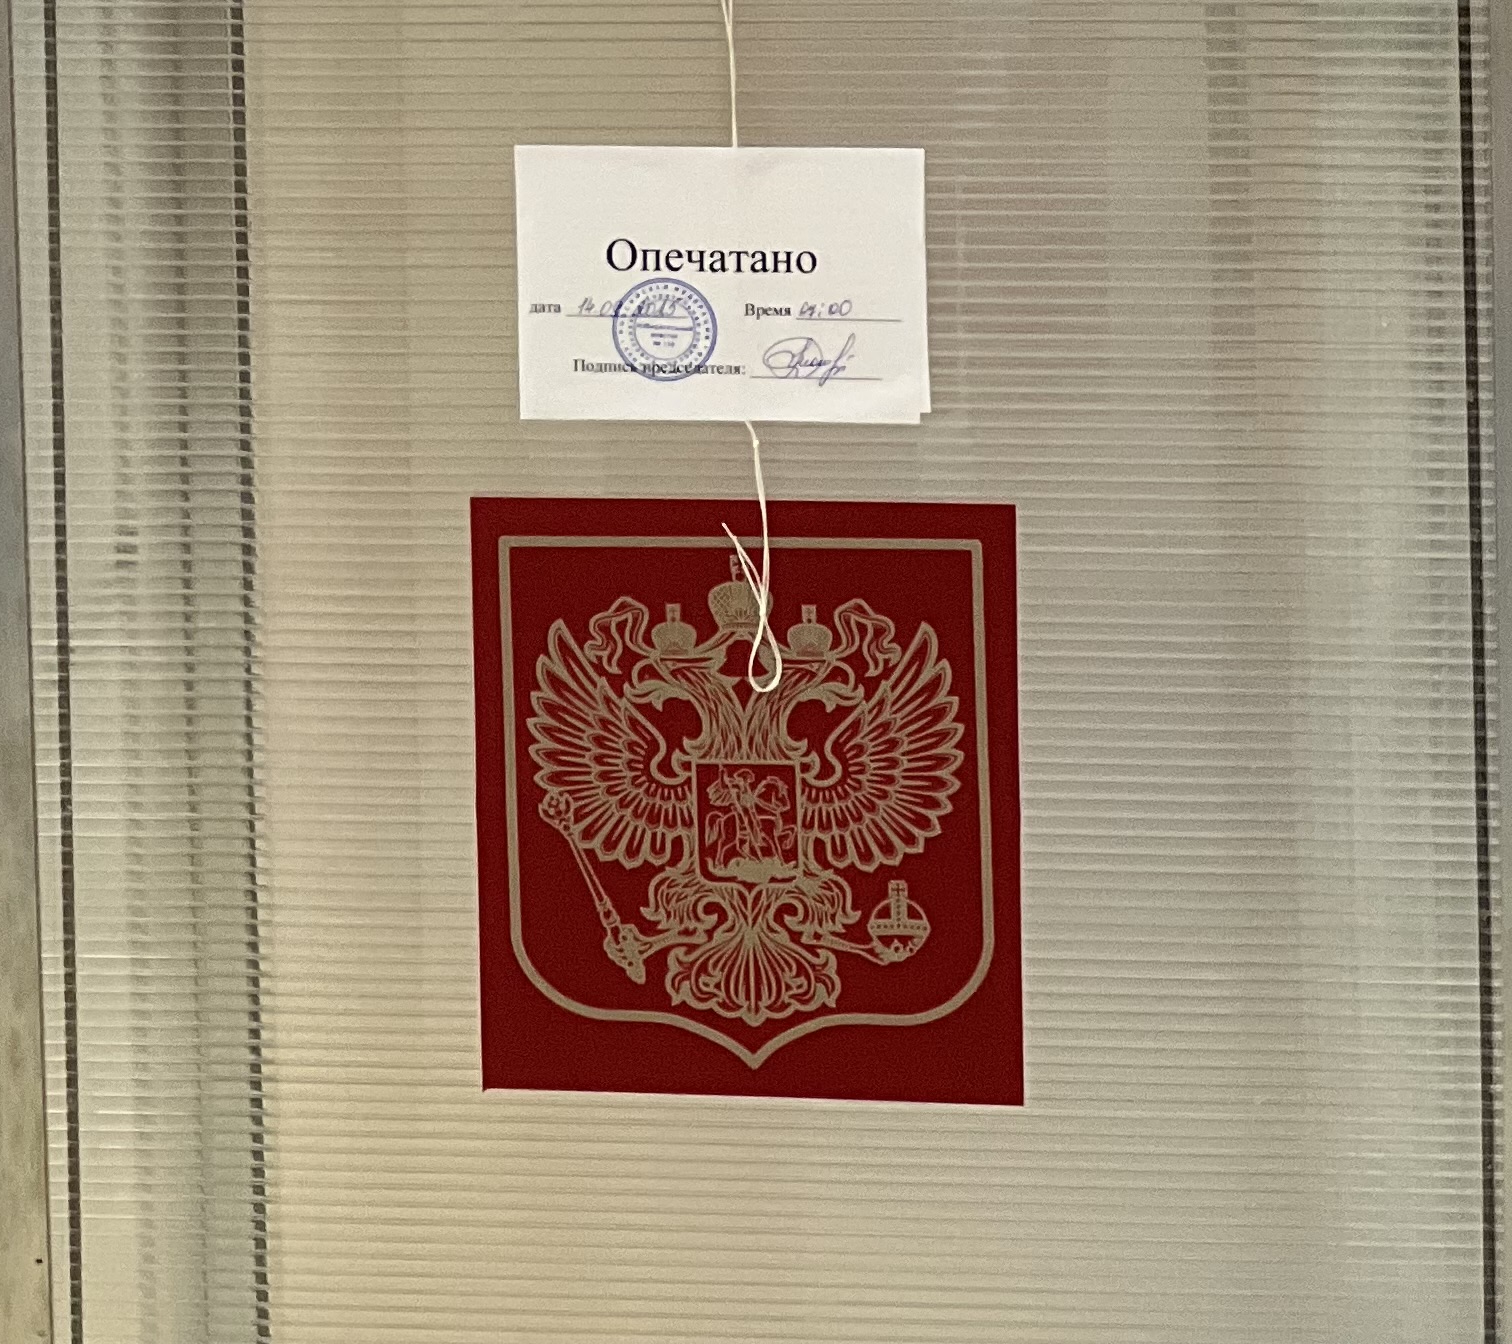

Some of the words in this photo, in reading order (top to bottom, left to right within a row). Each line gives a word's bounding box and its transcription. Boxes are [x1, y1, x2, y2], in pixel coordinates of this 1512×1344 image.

[606, 238, 818, 274] Опечатано
[529, 301, 562, 315] дата
[744, 302, 792, 321] Время
